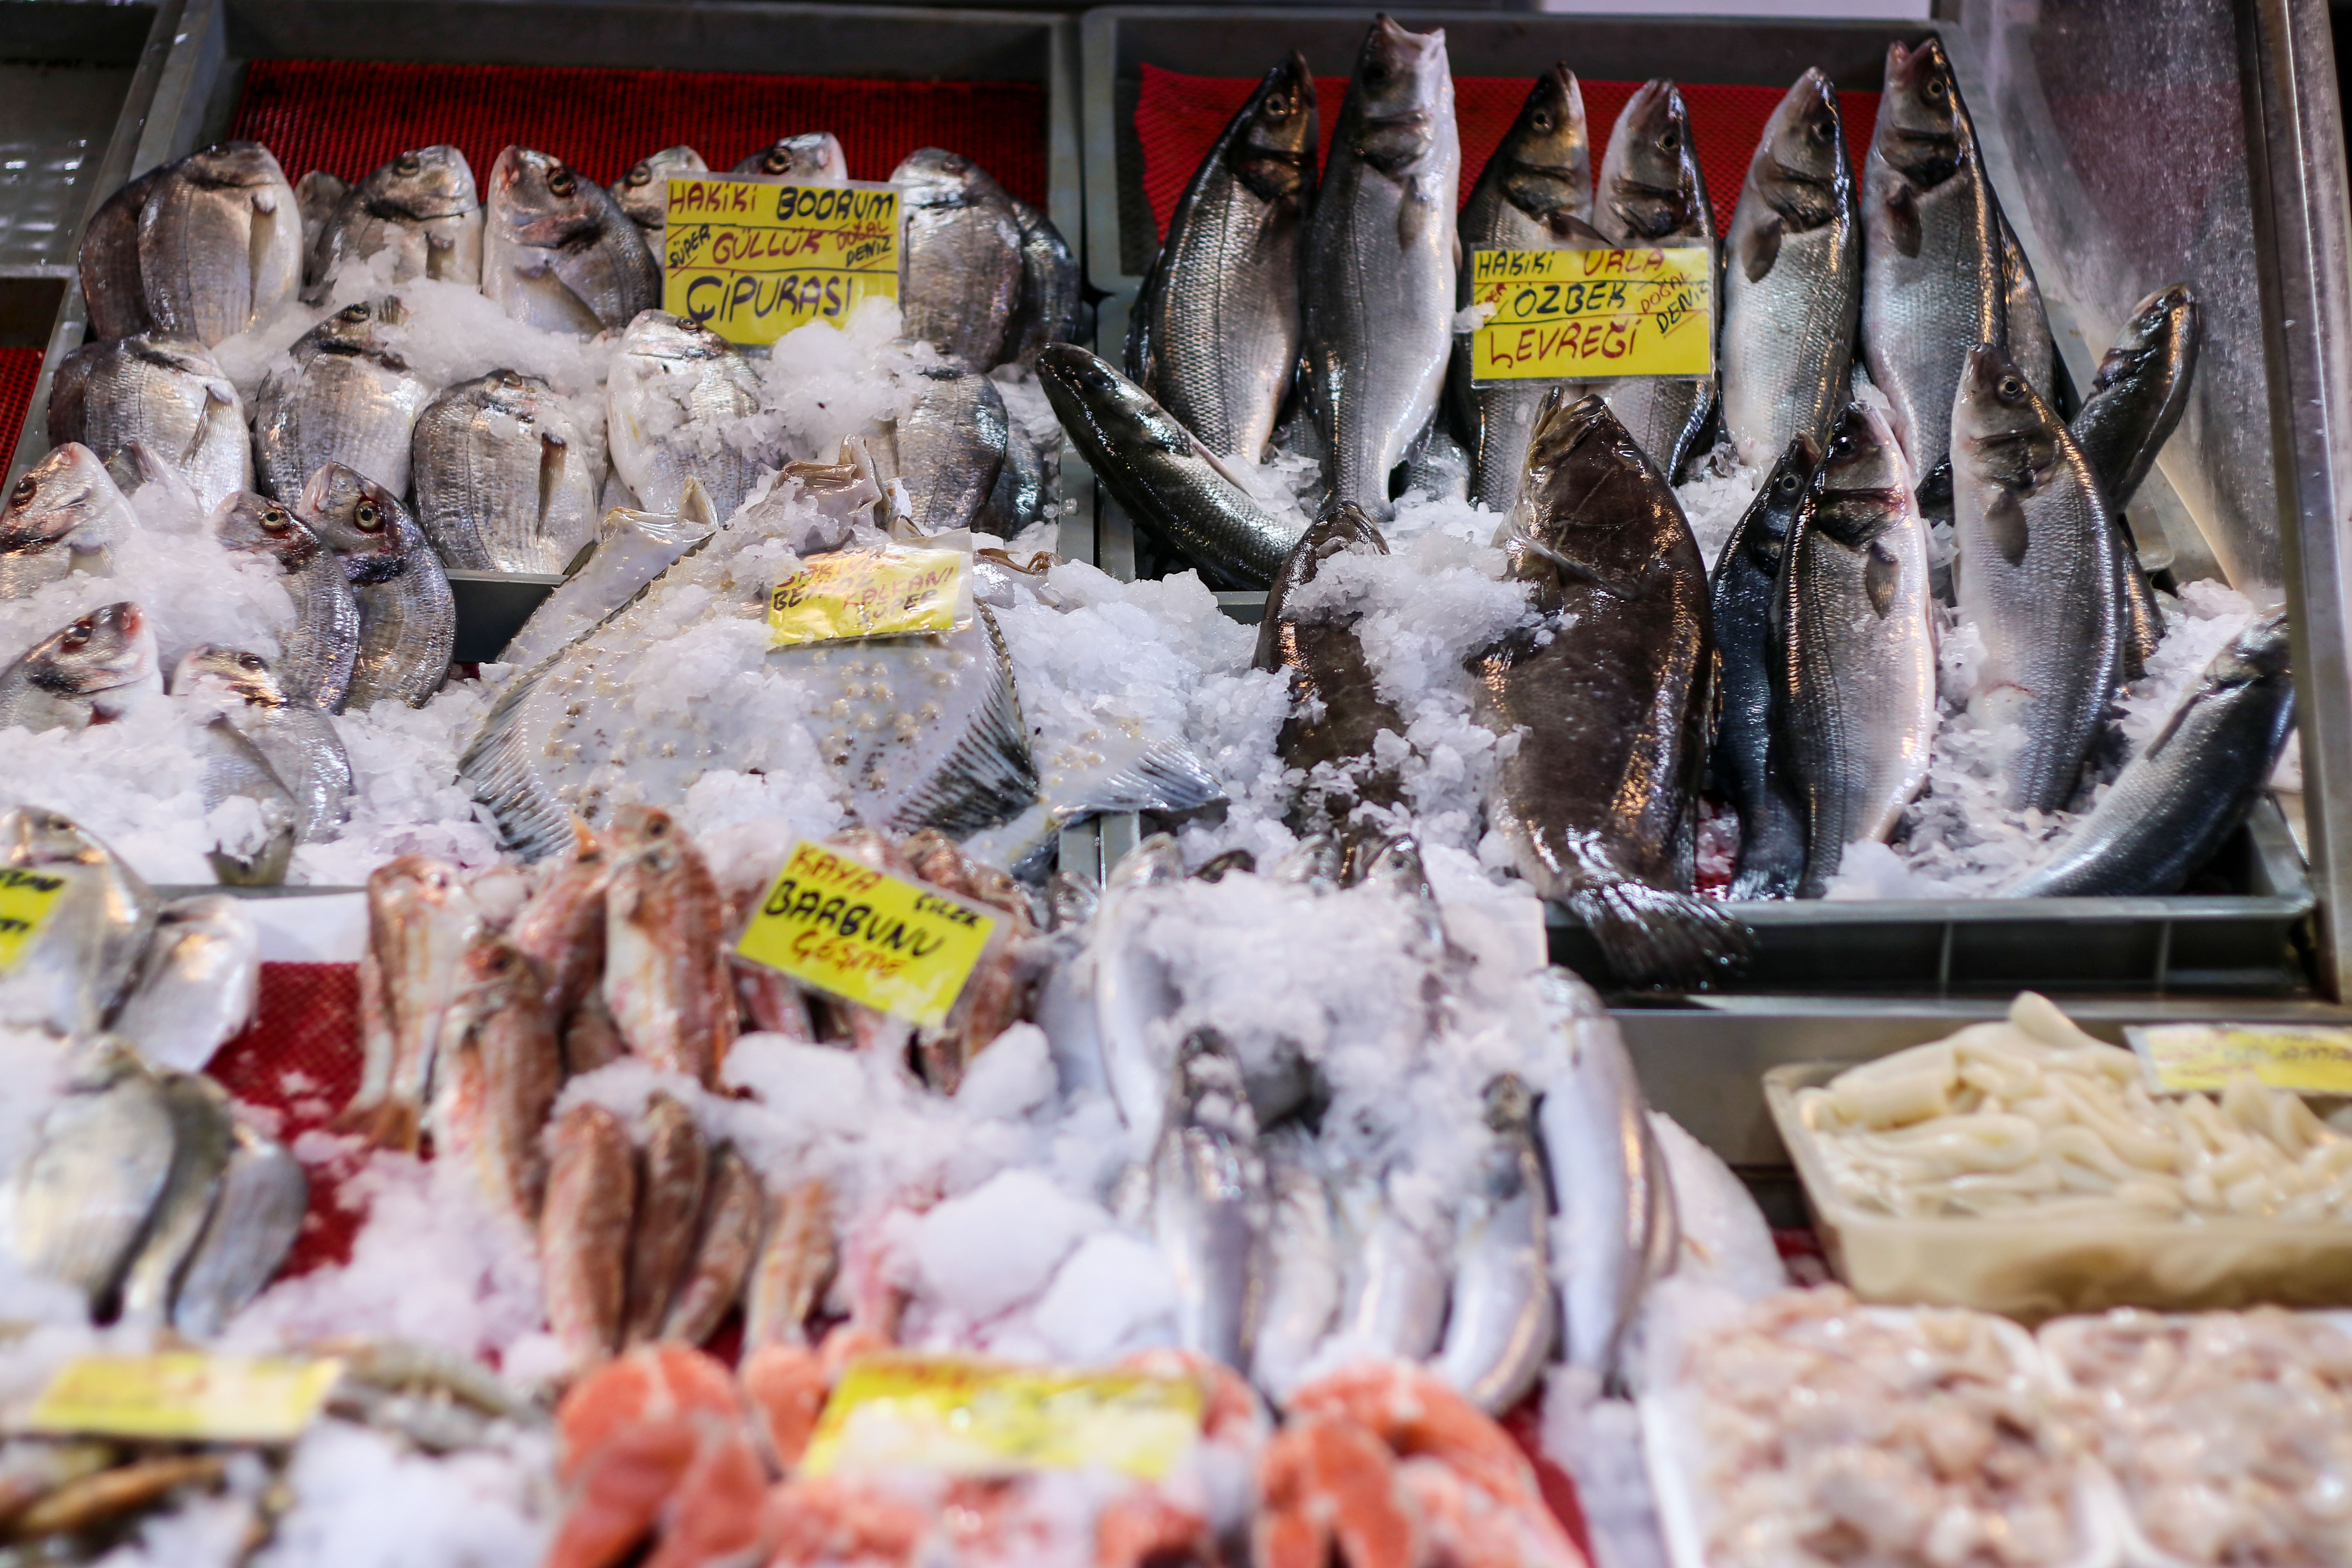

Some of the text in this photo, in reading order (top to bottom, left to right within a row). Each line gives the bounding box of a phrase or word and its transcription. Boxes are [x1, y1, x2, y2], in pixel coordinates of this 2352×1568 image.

[668, 181, 894, 220] HAKİKİ BODRUM
[712, 226, 826, 264] GÜLLÜK
[1477, 249, 1665, 279] HAKİKİ URLA
[686, 270, 852, 322] ÇİPURASI
[1514, 279, 1627, 317] ÖZBEK
[1491, 318, 1642, 368] LEVREĞİ
[844, 566, 953, 610] KALKANI
[789, 848, 883, 895] KAYA
[764, 879, 945, 958] BARBUNU
